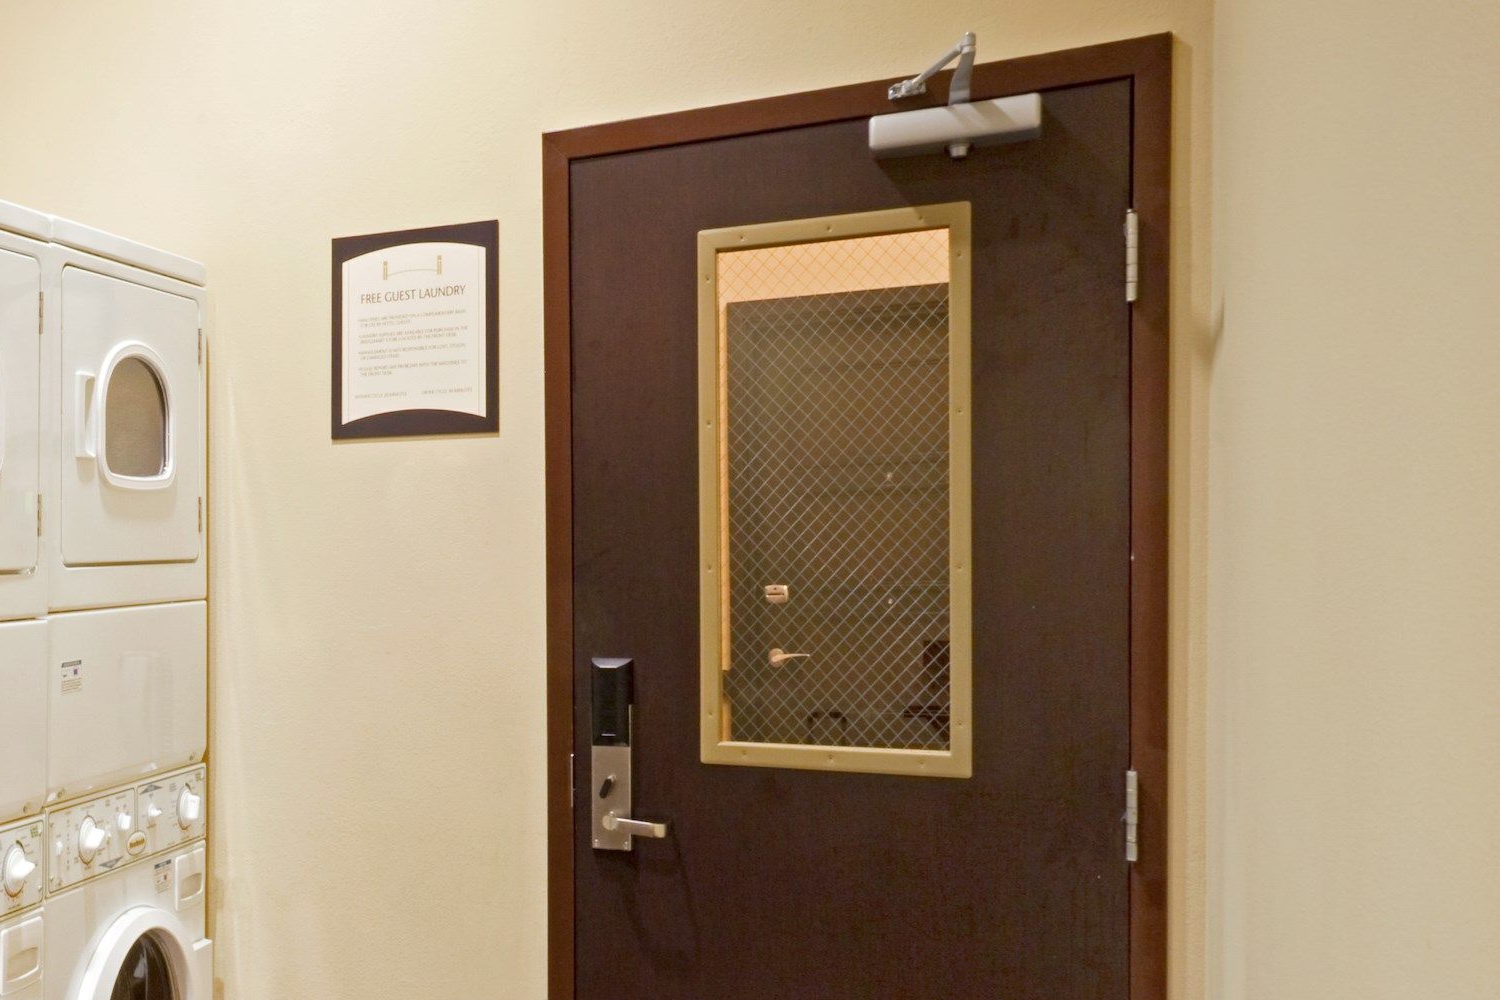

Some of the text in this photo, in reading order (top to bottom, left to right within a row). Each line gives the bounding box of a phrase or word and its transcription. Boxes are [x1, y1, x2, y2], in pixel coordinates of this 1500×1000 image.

[360, 285, 466, 304] FREE GUEST LAUNDRY
